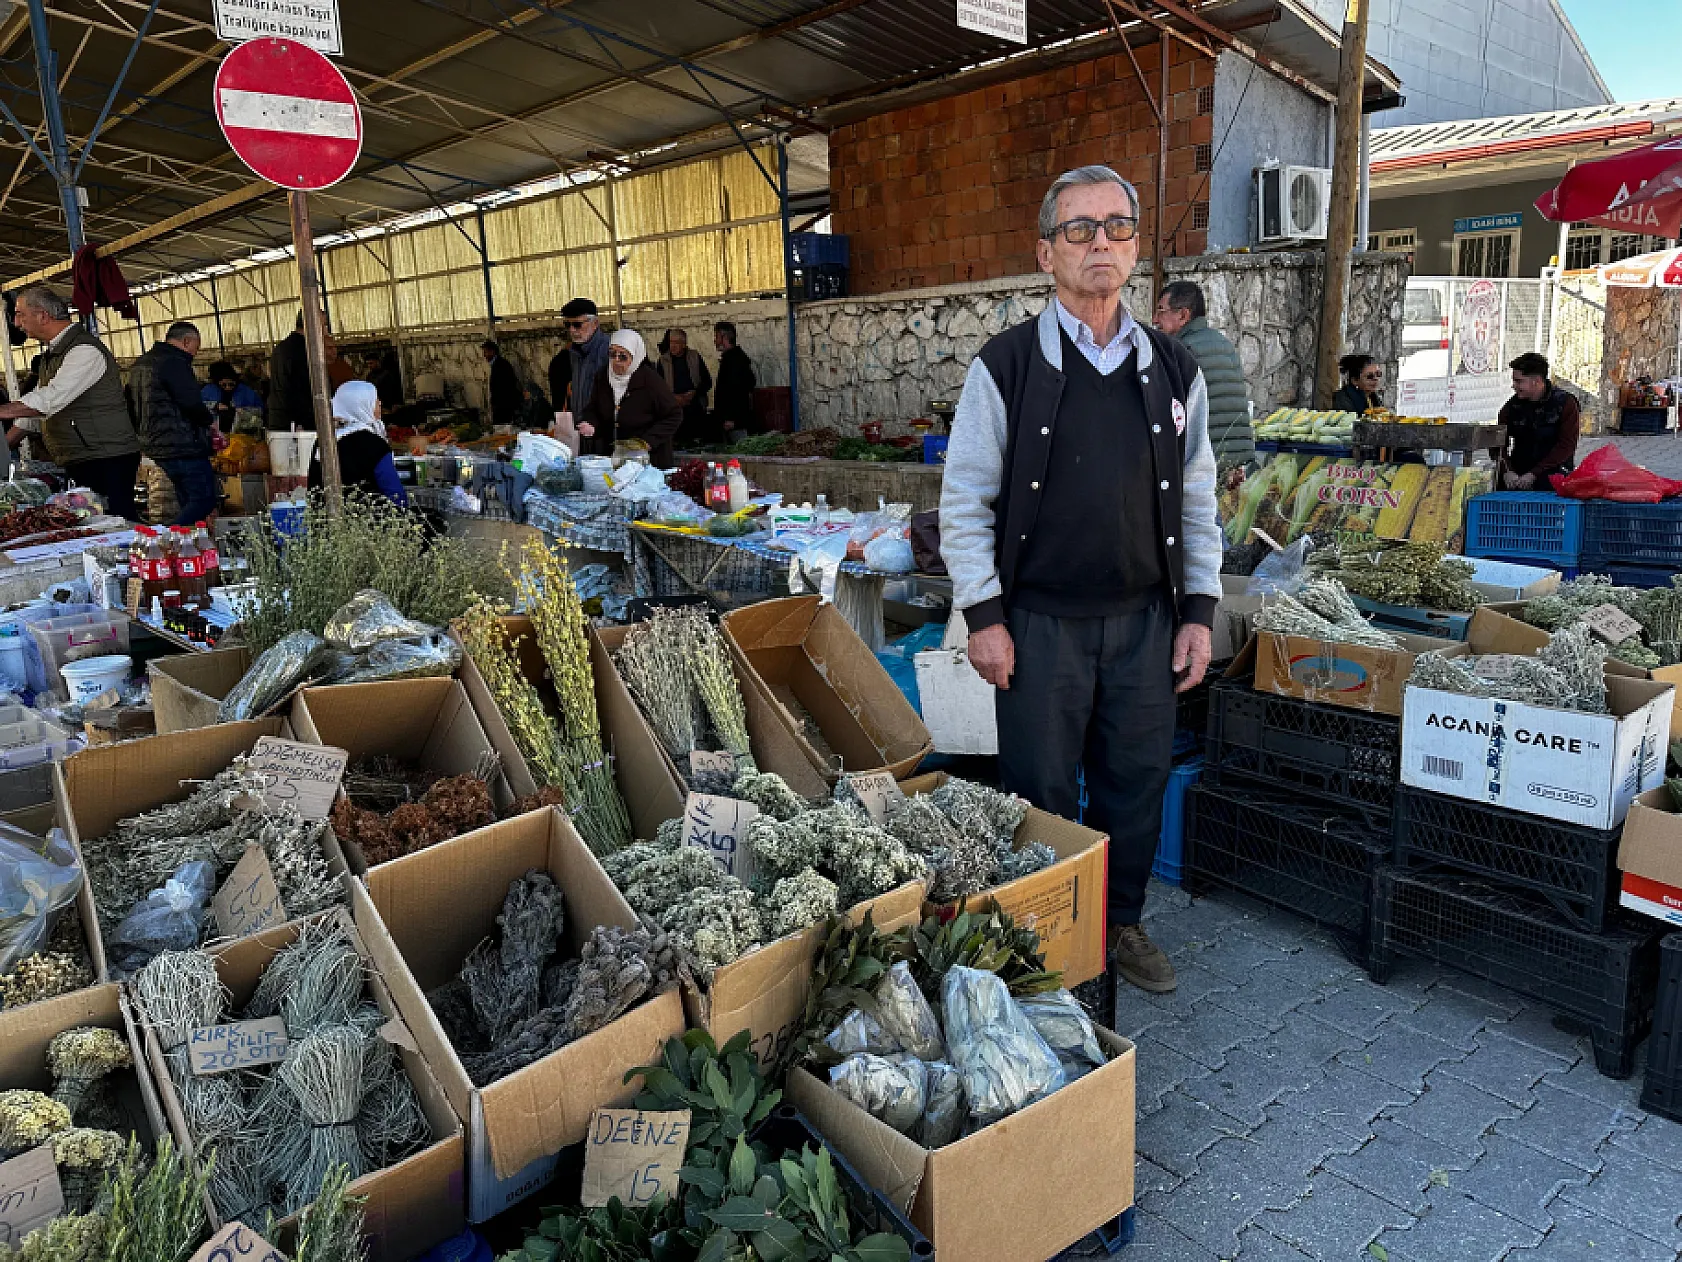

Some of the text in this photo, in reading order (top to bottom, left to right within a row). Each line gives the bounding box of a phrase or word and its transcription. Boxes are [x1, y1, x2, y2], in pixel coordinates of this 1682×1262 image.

[223, 14, 277, 32] Trafiğine
[1326, 463, 1375, 484] BBQ
[1317, 484, 1404, 509] CORN
[191, 1024, 241, 1044] KIRK
[629, 1164, 661, 1202] 15
